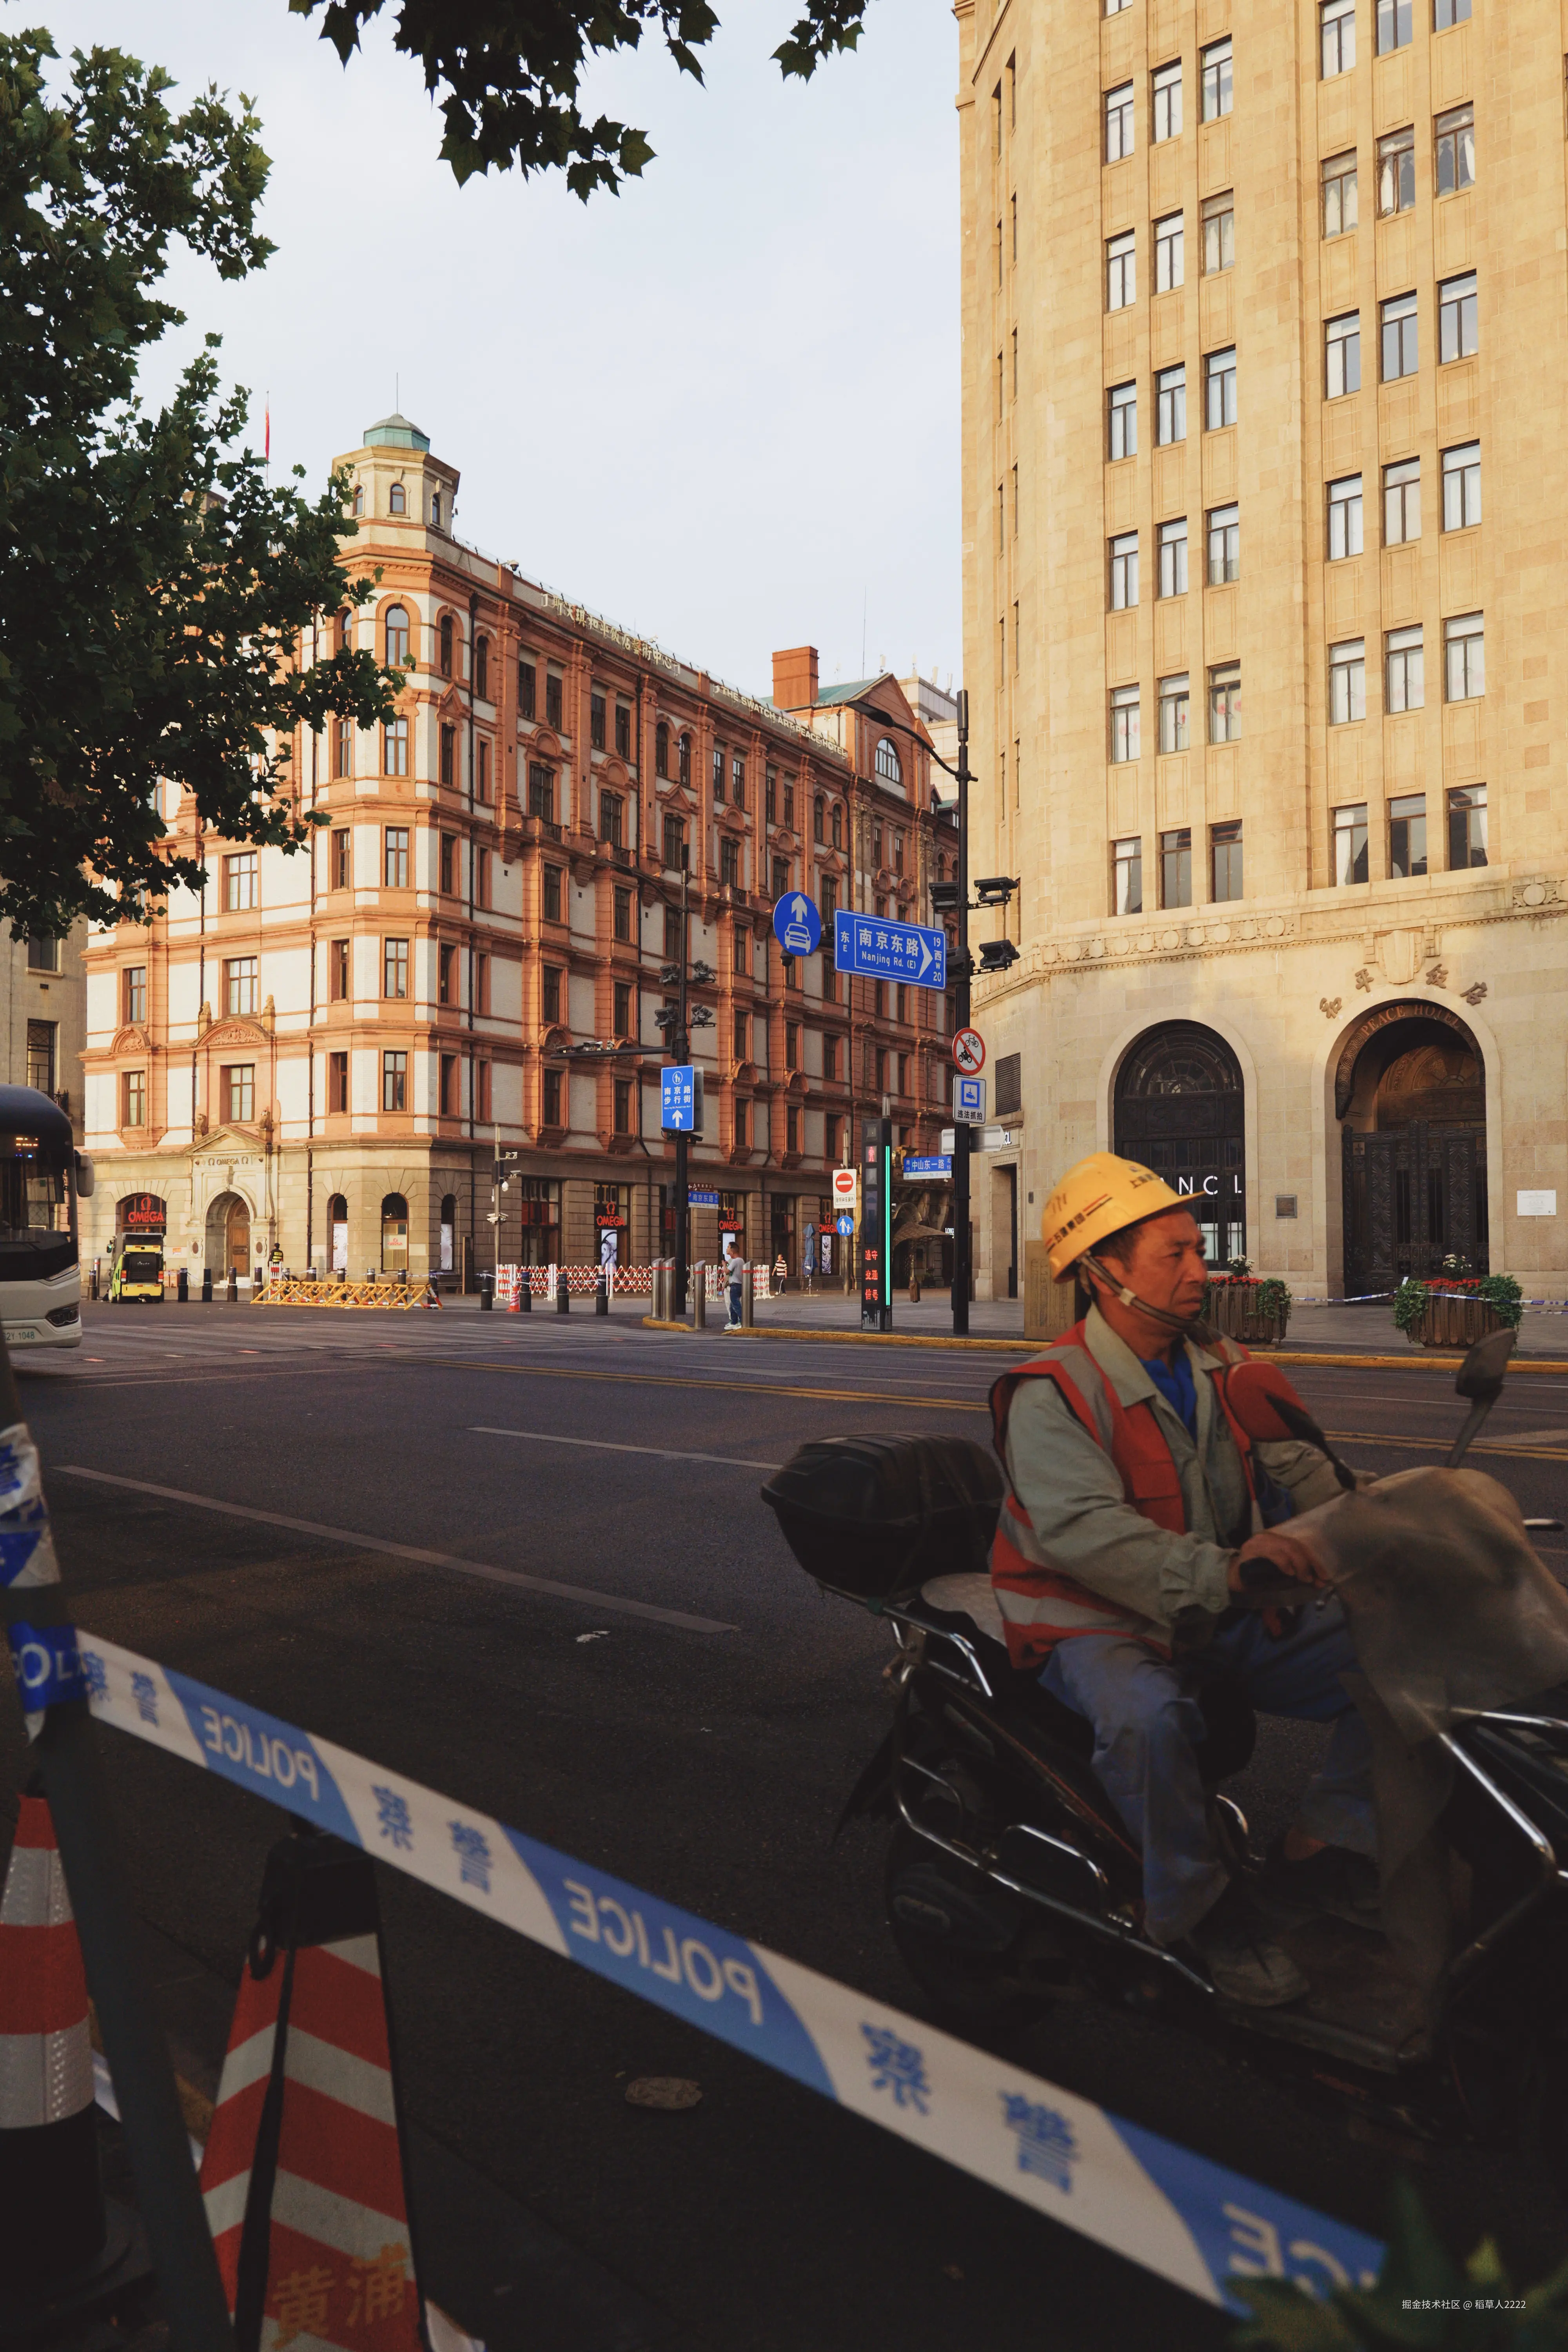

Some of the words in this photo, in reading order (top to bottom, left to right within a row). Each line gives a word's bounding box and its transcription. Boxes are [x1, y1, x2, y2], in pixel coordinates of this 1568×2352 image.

[721, 686, 738, 702] THE
[740, 697, 776, 721] SWATCH
[778, 717, 794, 730] ART
[796, 726, 821, 744] PEACE
[822, 739, 846, 757] HOTEL
[840, 931, 850, 943] 东
[859, 928, 919, 957] 南京东路
[933, 936, 941, 947] 19
[862, 951, 890, 967] Nanjing
[893, 957, 904, 967] Rd.
[907, 960, 916, 969] (E)
[934, 950, 942, 962] 西
[933, 971, 942, 982] 20
[1361, 1005, 1406, 1038] PEACE
[1414, 1004, 1461, 1029] HOTEL
[664, 1085, 691, 1096] 南京路
[664, 1095, 691, 1105] 步行街
[958, 1110, 983, 1121] 违法抓拍
[216, 1158, 240, 1166] OMEGA
[912, 1159, 944, 1170] 中山东一路
[1160, 1175, 1242, 1196] NCL
[692, 1194, 713, 1202] 南京东路
[128, 1210, 165, 1223] OMEGA
[596, 1215, 626, 1227] OMEGA
[719, 1220, 742, 1231] OMEGA
[865, 1270, 878, 1280] 交通
[865, 1289, 878, 1300] 信号
[272, 2241, 408, 2350] 黄浦
